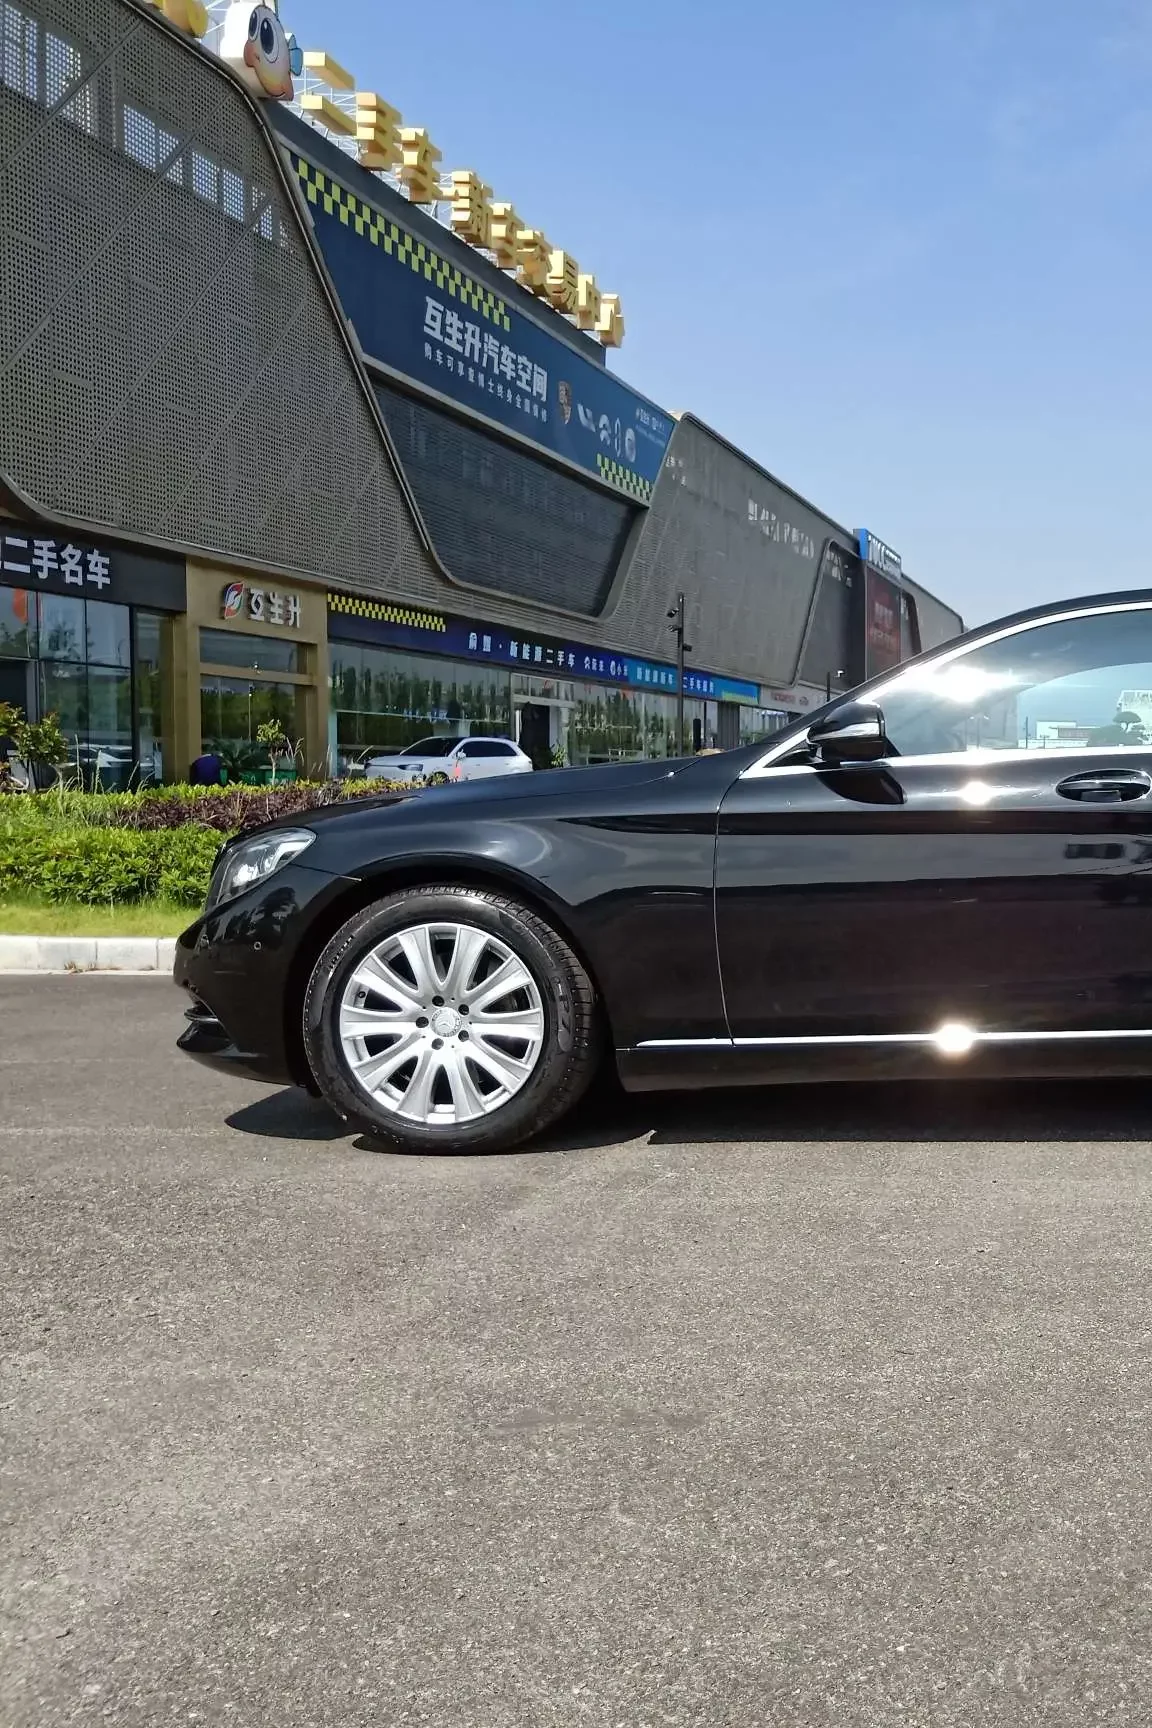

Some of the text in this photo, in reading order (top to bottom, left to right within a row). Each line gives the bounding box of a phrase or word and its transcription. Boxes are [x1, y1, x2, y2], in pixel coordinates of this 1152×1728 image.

[423, 295, 548, 403] 互生升汽车空间
[0, 535, 111, 590] 二手名车
[248, 587, 301, 629] 互生升
